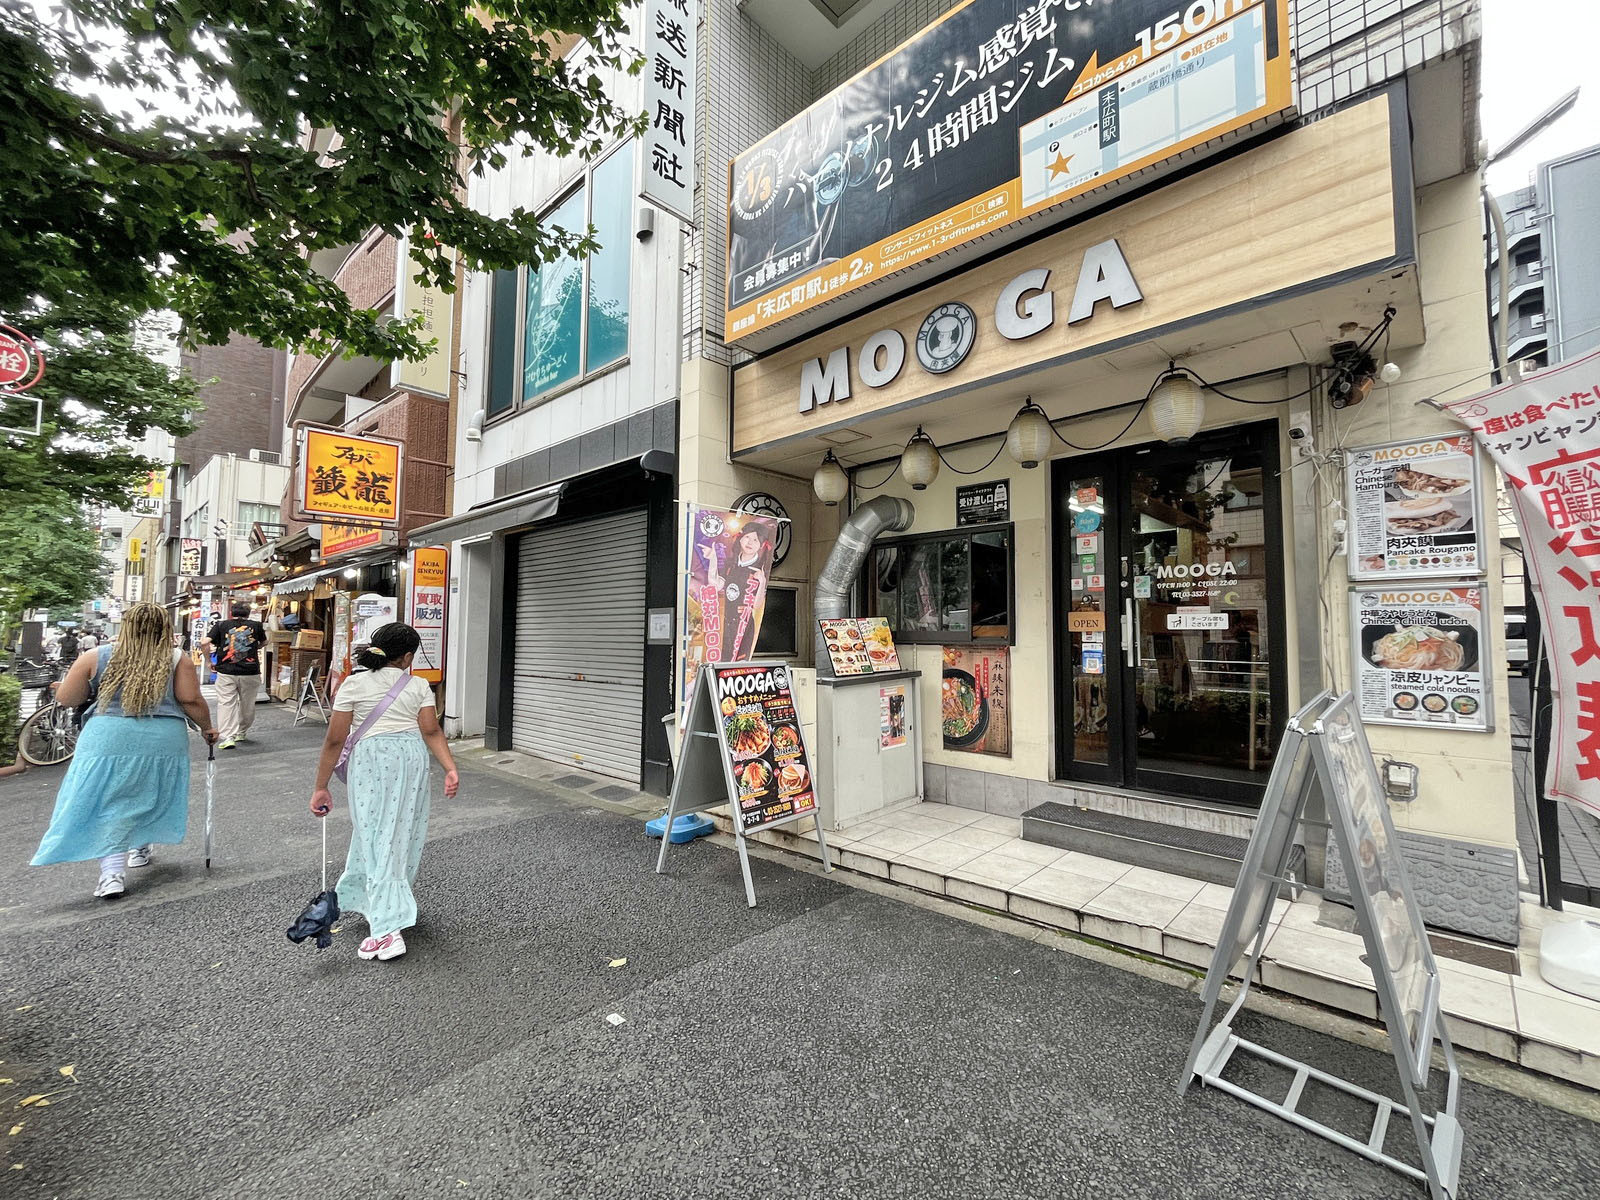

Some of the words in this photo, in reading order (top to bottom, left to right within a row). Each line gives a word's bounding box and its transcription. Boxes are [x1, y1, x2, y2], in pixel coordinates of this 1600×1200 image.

[1191, 31, 1229, 57] 現在地
[1073, 54, 1138, 97] ココから4分
[1147, 57, 1206, 94] 蔵前橋通り
[1101, 90, 1117, 142] 末広町駅
[880, 209, 1009, 270] https://www.1-3rdfitness.com
[884, 218, 954, 254] ワンサードフィットネス
[1483, 411, 1600, 455] ャンビャン
[331, 445, 374, 465] アキバ
[1374, 441, 1447, 461] MOOGA
[1355, 475, 1393, 484] Chinese
[136, 499, 161, 509] FUJI
[1387, 548, 1426, 557] Pancake
[1429, 545, 1476, 555] Rougamo
[1157, 562, 1237, 579] MOOGA
[416, 593, 443, 605] 買取
[1381, 592, 1456, 603] MOOGA
[415, 607, 442, 620] 販売
[1360, 609, 1436, 617] 中華冷やしうどん
[1073, 619, 1099, 628] OPEN
[1361, 617, 1400, 625] Chinese
[1402, 617, 1437, 625] chilled
[1391, 670, 1480, 686] 涼皮リャンピー
[719, 672, 776, 699] MOOGA
[1447, 686, 1480, 694] noodles
[738, 694, 777, 704] おすすめメニュー
[800, 798, 812, 807] OK!
